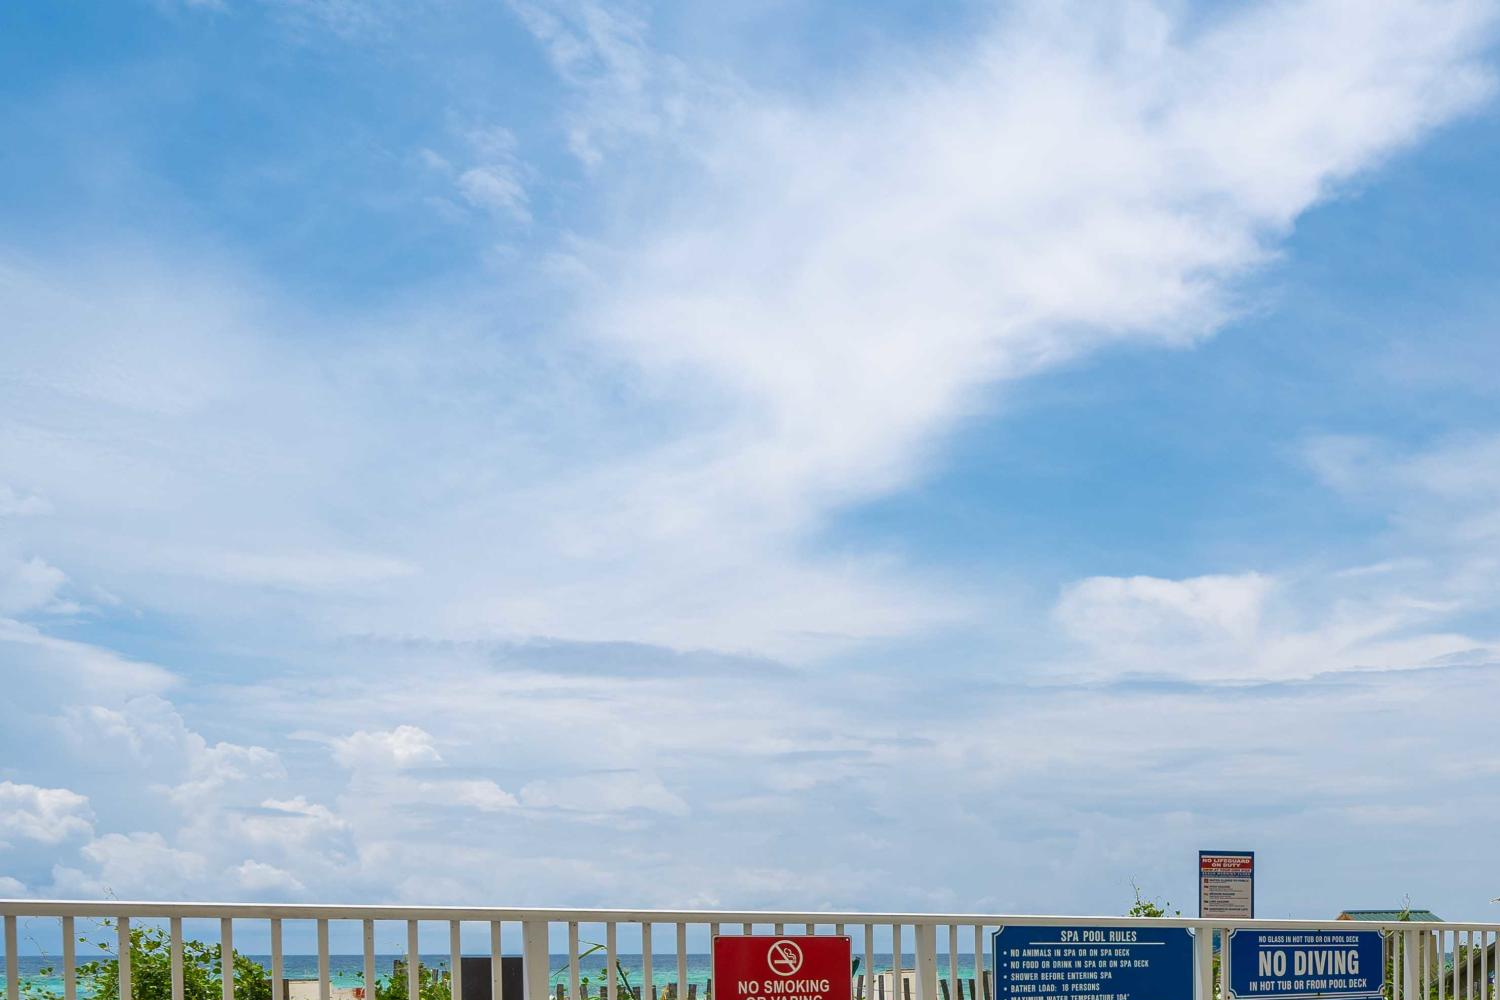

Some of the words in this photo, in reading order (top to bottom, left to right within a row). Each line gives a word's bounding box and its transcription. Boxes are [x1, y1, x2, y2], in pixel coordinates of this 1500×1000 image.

[1061, 931, 1078, 941] SPA
[1083, 931, 1105, 941] POOL
[1110, 931, 1136, 941] RULES
[1259, 951, 1286, 976] NO
[1294, 950, 1358, 975] DIVING
[738, 981, 759, 994] NO
[764, 980, 829, 993] SMOKING
[1250, 981, 1257, 991] IN
[1260, 981, 1274, 991] HOT
[1277, 981, 1291, 990] TUB
[1294, 980, 1304, 990] OR
[1306, 980, 1326, 989] FROM
[1329, 979, 1347, 988] POOL
[1349, 979, 1367, 988] DECK
